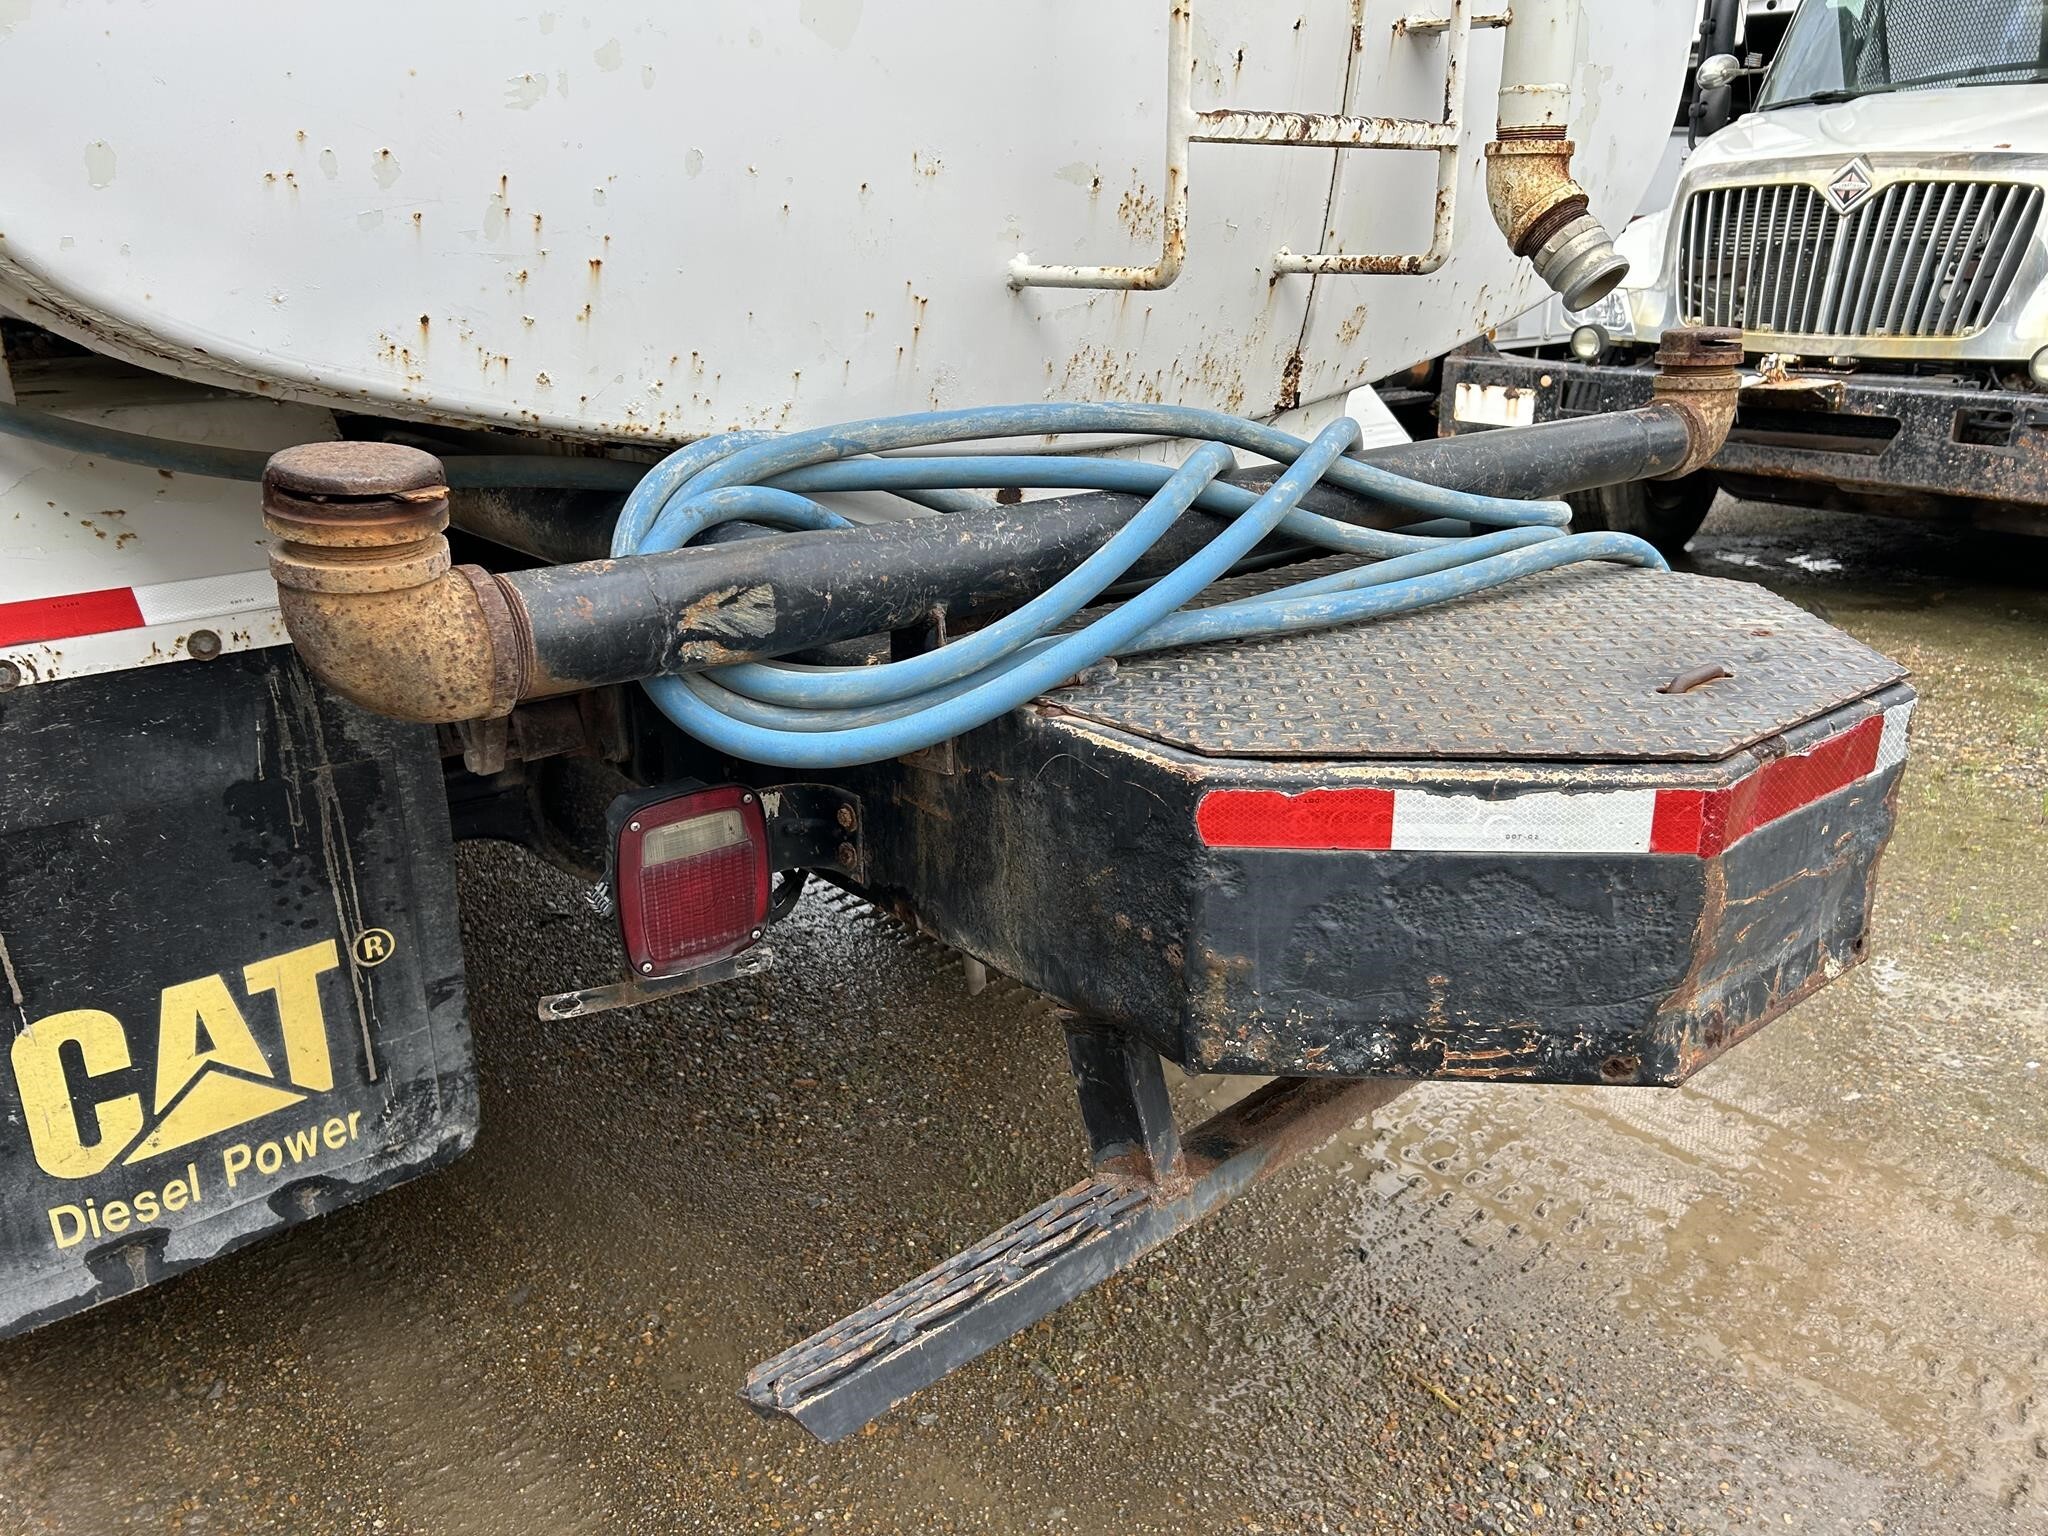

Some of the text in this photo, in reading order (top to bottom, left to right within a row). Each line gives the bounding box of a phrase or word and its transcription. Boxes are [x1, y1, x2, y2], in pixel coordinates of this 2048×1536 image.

[11, 939, 339, 1180] CAT
[48, 1110, 362, 1250] Diesel Power
